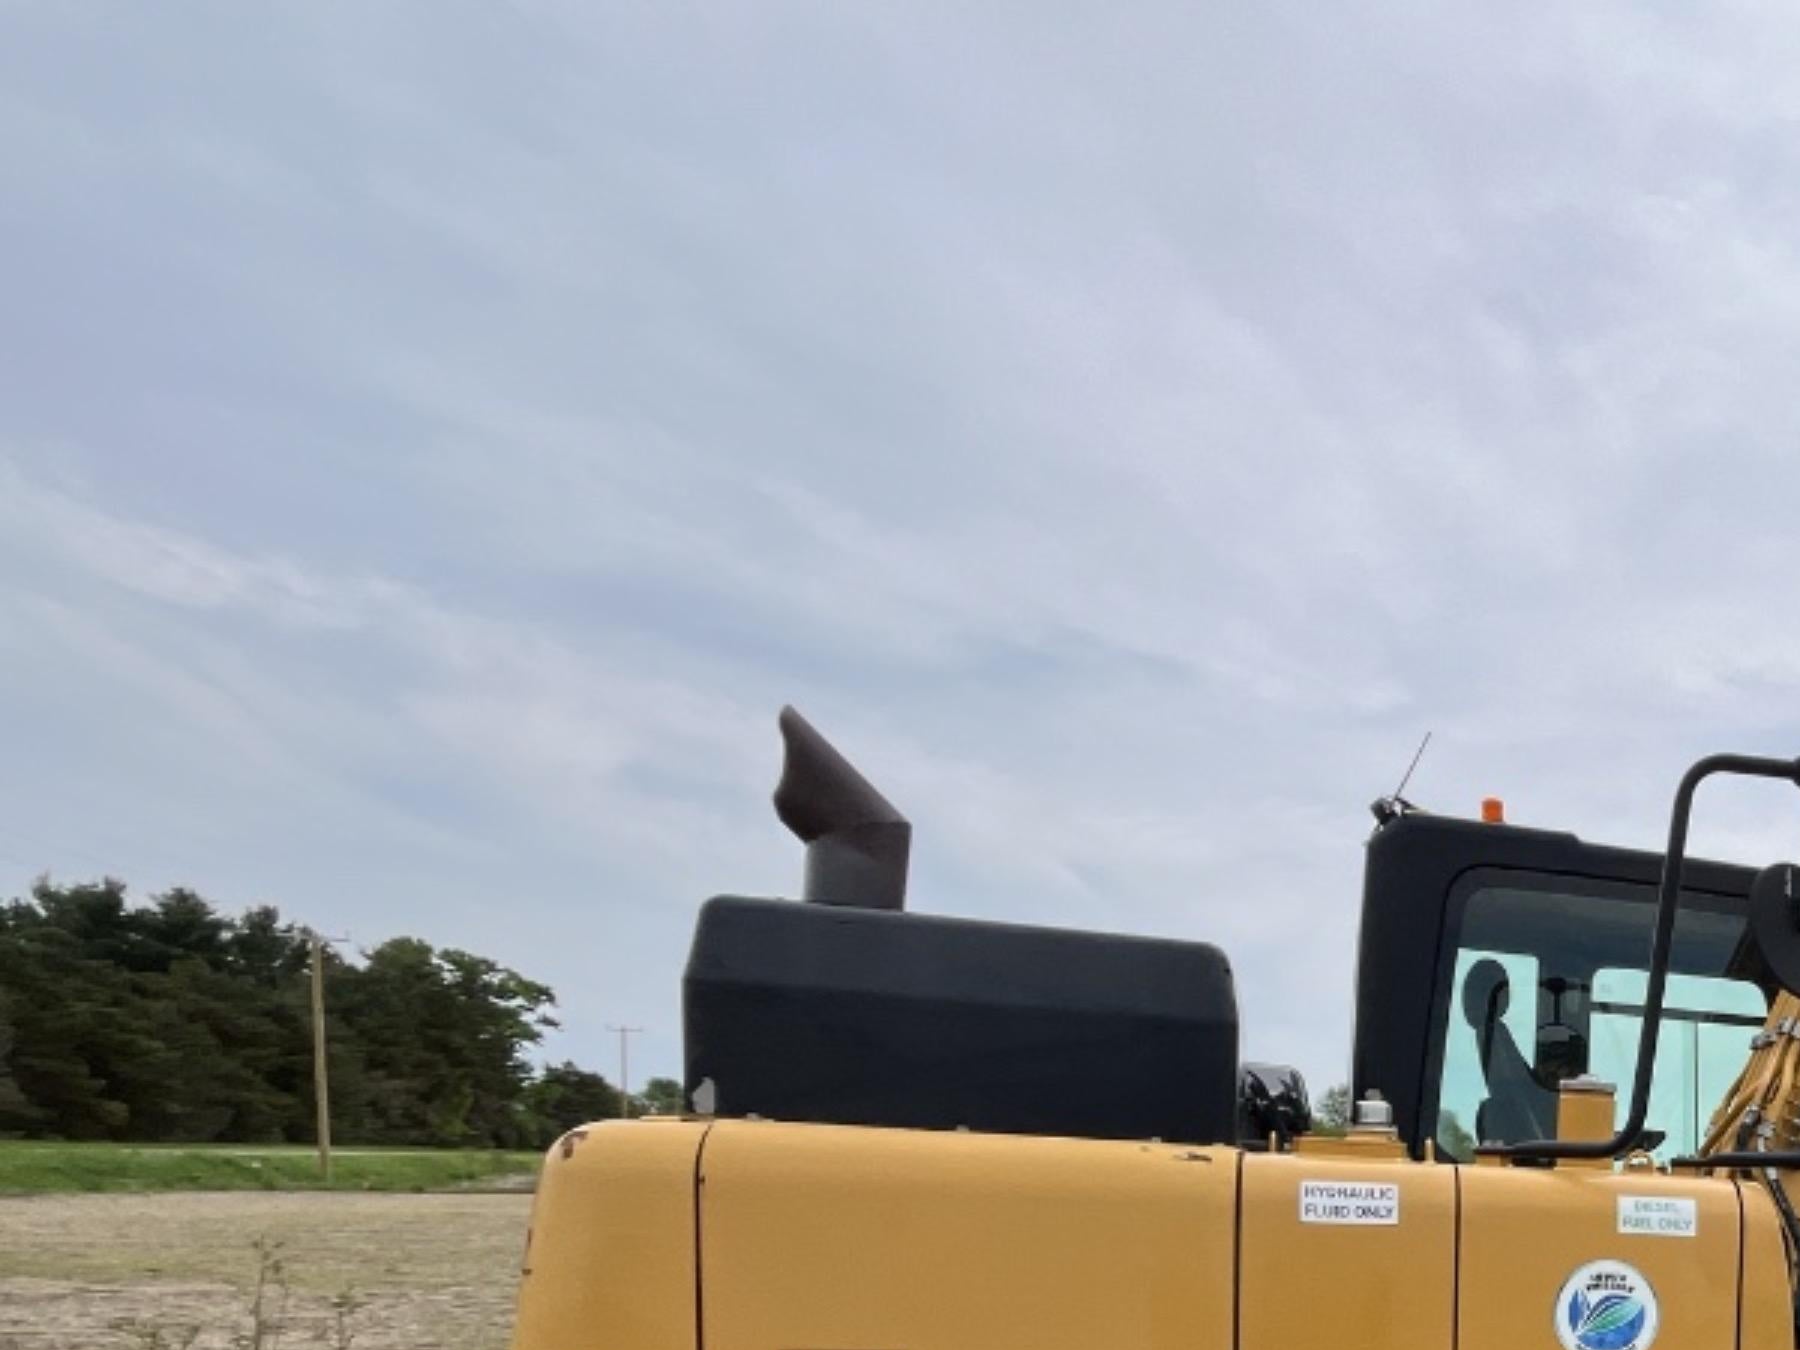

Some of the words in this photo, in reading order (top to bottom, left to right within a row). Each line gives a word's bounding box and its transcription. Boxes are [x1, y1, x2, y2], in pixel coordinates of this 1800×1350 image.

[1304, 1184, 1394, 1201] HYDRAULIC
[1304, 1202, 1350, 1219] FLUID
[1353, 1204, 1395, 1219] ONLY
[1658, 1217, 1693, 1231] ONLY
